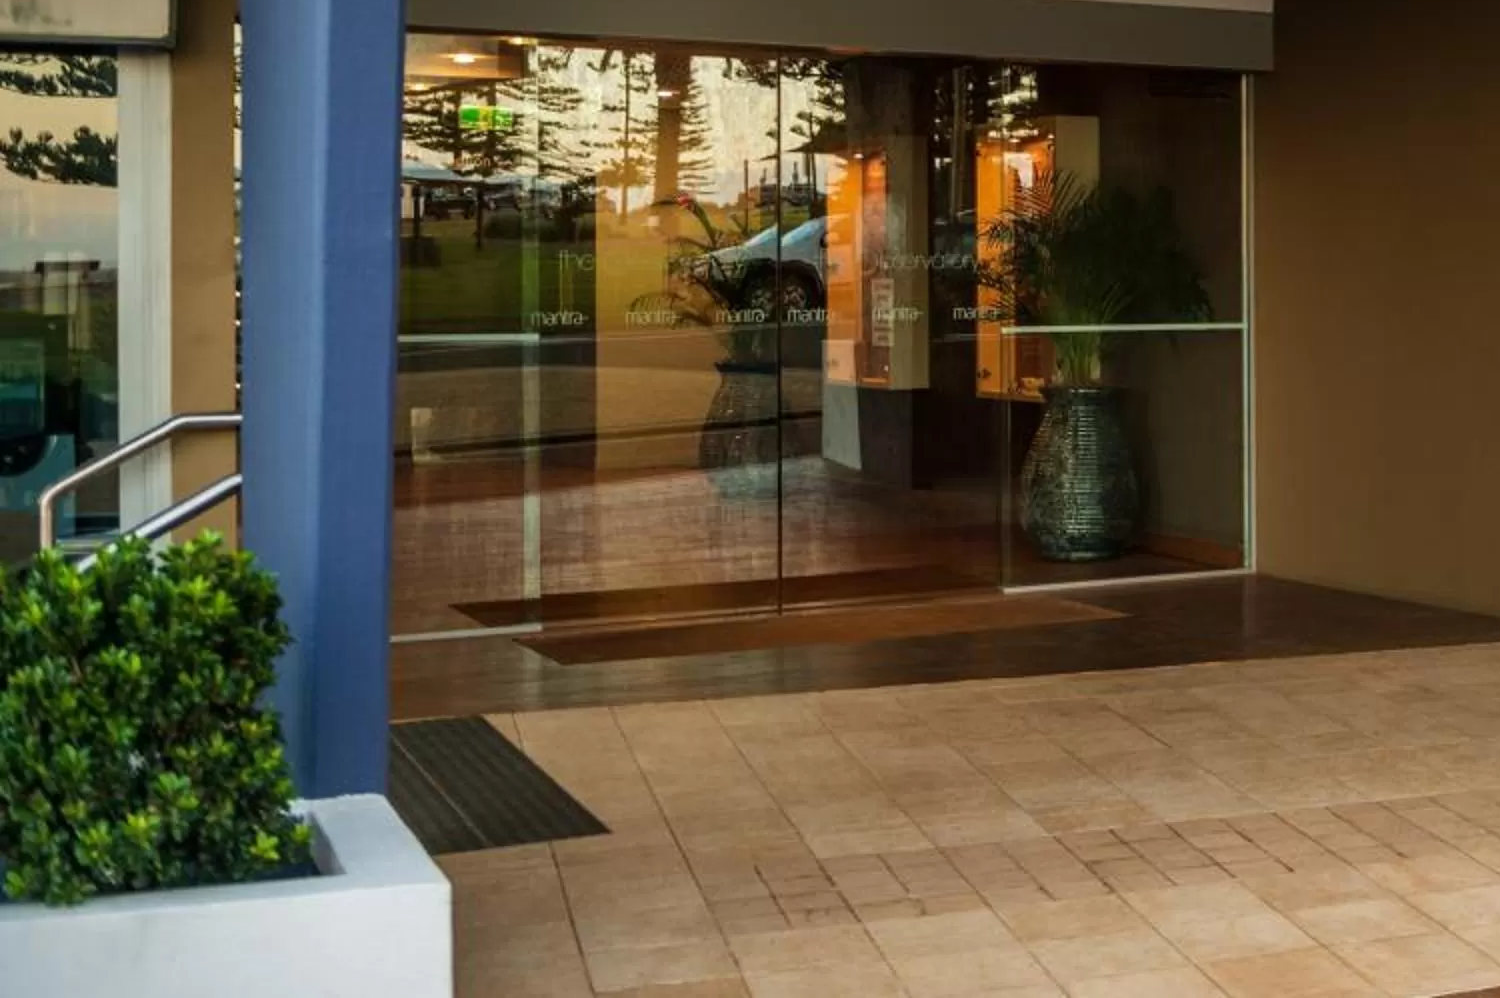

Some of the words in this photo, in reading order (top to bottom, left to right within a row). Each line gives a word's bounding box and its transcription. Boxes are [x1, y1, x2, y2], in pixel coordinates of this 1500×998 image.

[530, 307, 589, 327] mantra
[624, 307, 681, 327] mantra
[715, 307, 770, 325] mantra
